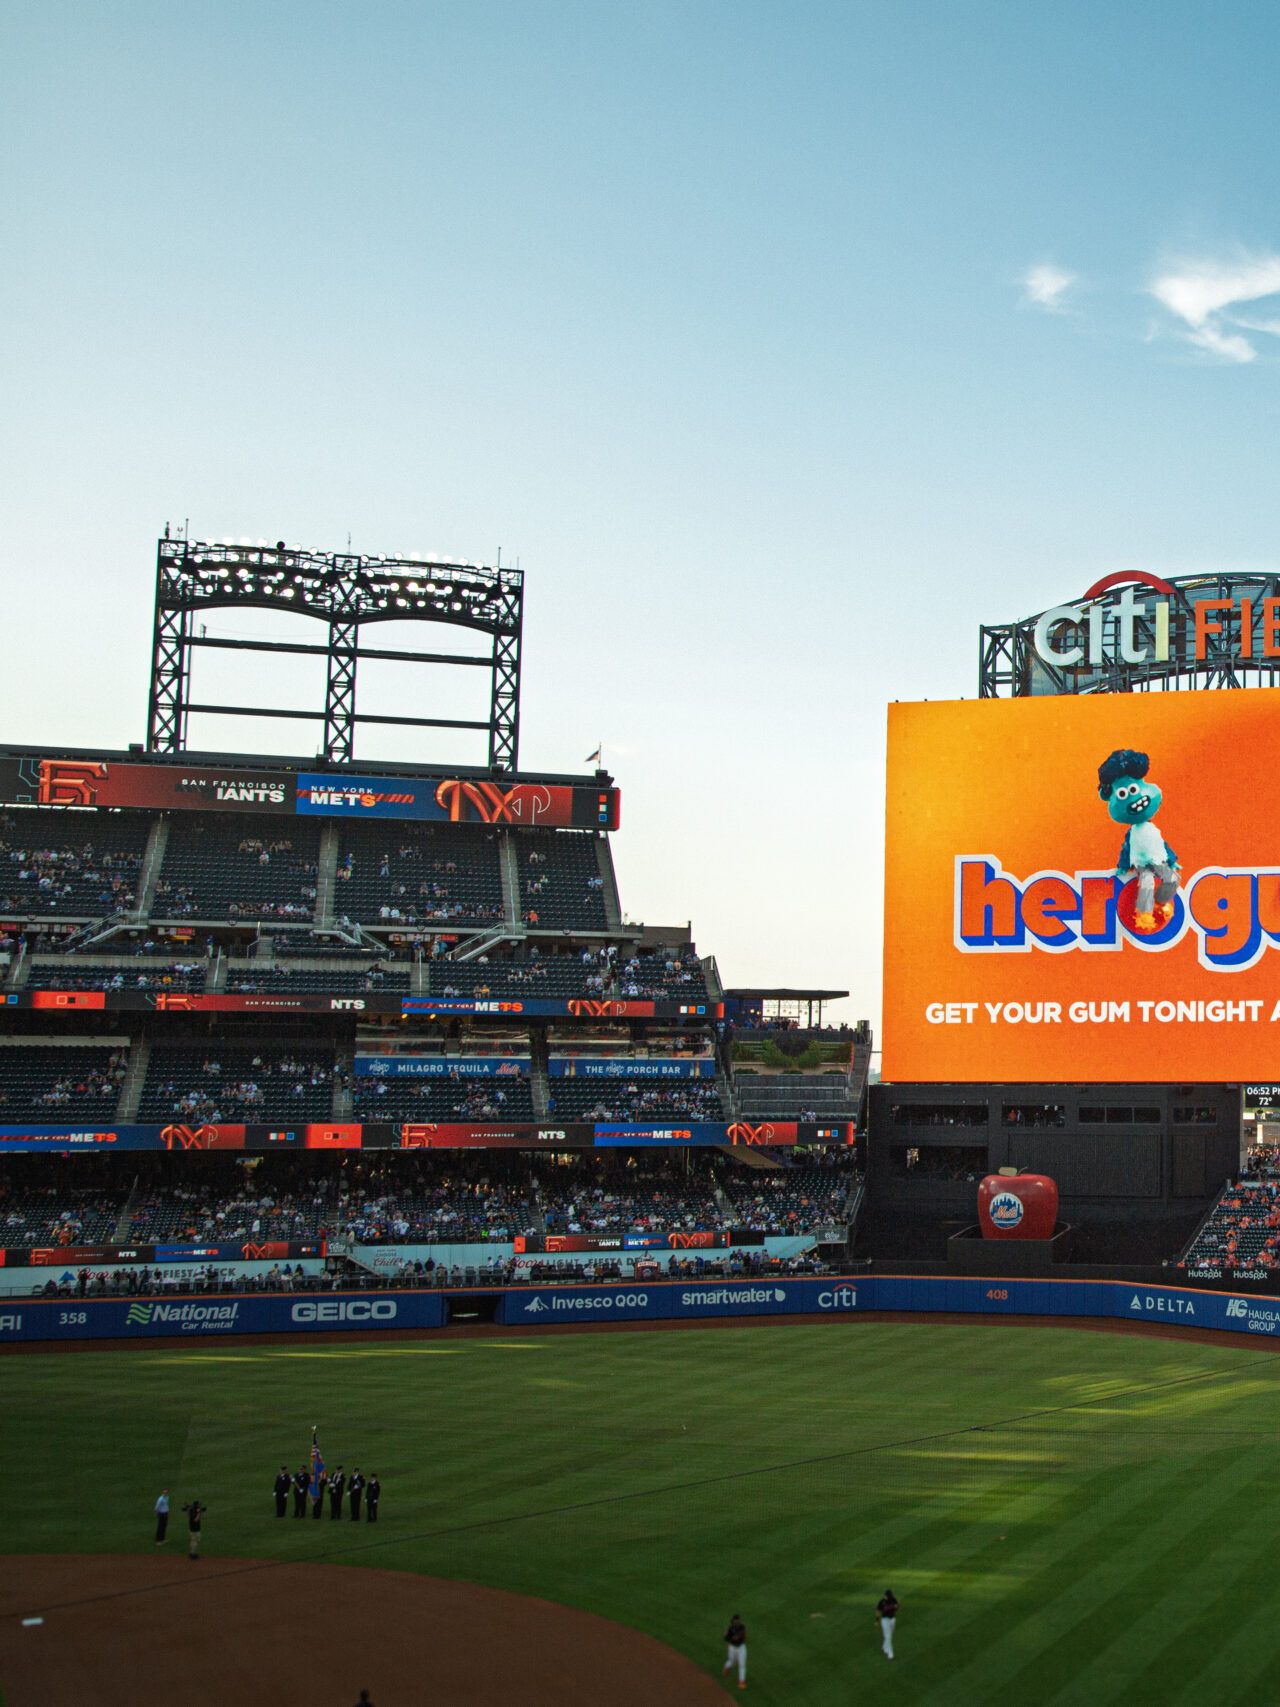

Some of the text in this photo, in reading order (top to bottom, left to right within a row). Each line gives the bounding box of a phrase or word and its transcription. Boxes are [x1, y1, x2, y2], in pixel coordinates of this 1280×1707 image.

[181, 778, 286, 790] SAN FRANCISCO
[311, 785, 335, 793] NEW
[216, 788, 285, 802] IANTS
[310, 793, 376, 807] METS
[330, 999, 366, 1010] NTS
[475, 1001, 524, 1012] METS
[925, 1002, 978, 1024] GET
[984, 1001, 1062, 1023] YOUR
[1068, 1001, 1131, 1023] GUM
[1137, 1000, 1264, 1022] TONIGHT
[397, 1064, 443, 1073] MILAGRO
[447, 1064, 490, 1073] TEQUILA
[585, 1065, 603, 1074] THE
[627, 1066, 658, 1074] PORCH
[662, 1066, 681, 1074] BAR
[1247, 1086, 1270, 1095] 06:52
[70, 1132, 118, 1143] METS
[537, 1130, 566, 1140] NTS
[652, 1130, 692, 1139] METS
[1188, 1268, 1222, 1280] HubSpot
[1233, 1269, 1268, 1281] HubSpot
[682, 1288, 772, 1305] smartwater
[817, 1287, 857, 1308] citi
[986, 1289, 1008, 1300] 408
[552, 1293, 648, 1310] Invesco QQQ
[1145, 1296, 1195, 1315] DELTA
[1226, 1298, 1248, 1317] HG
[152, 1302, 238, 1322] National
[291, 1300, 397, 1322] GEICO
[59, 1312, 87, 1325] 358
[181, 1320, 234, 1330] Car Rental
[1248, 1320, 1276, 1332] GROUP
